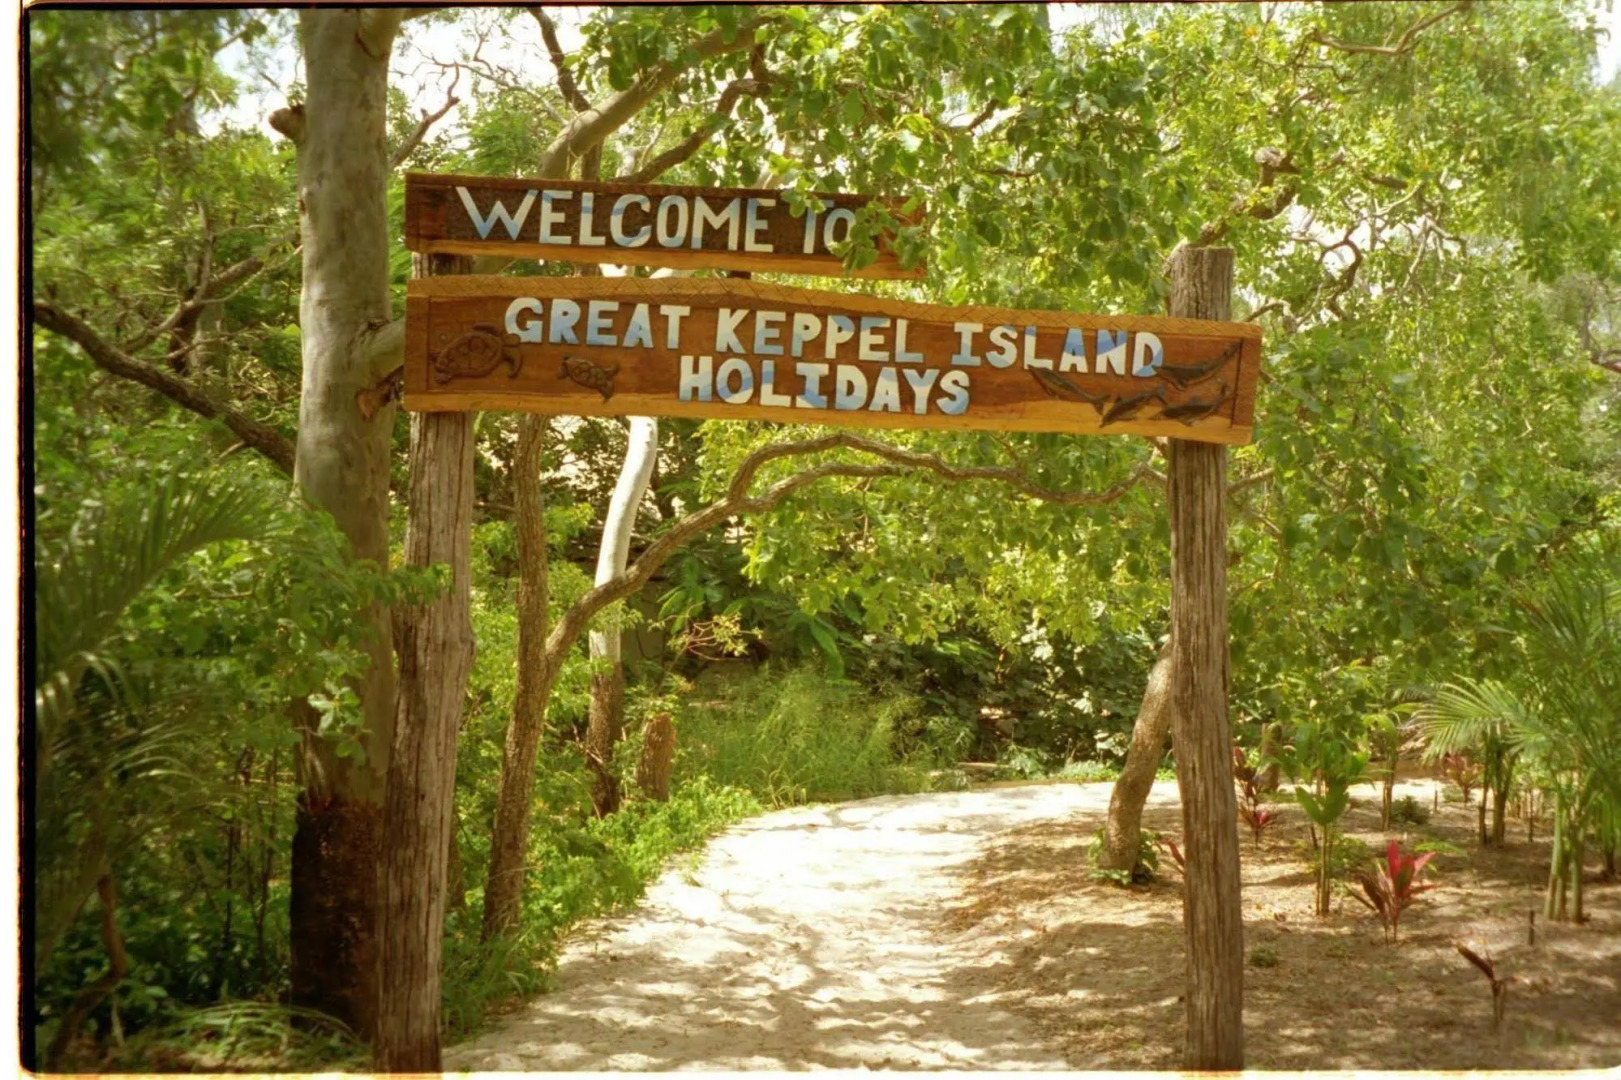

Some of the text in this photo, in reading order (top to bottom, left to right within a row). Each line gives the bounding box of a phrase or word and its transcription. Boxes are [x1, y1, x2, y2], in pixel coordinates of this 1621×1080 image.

[454, 185, 857, 255] WELCOME TO
[503, 297, 1164, 378] GREAT KEPPEL ISLAND
[678, 354, 971, 416] HOLIDAYS
